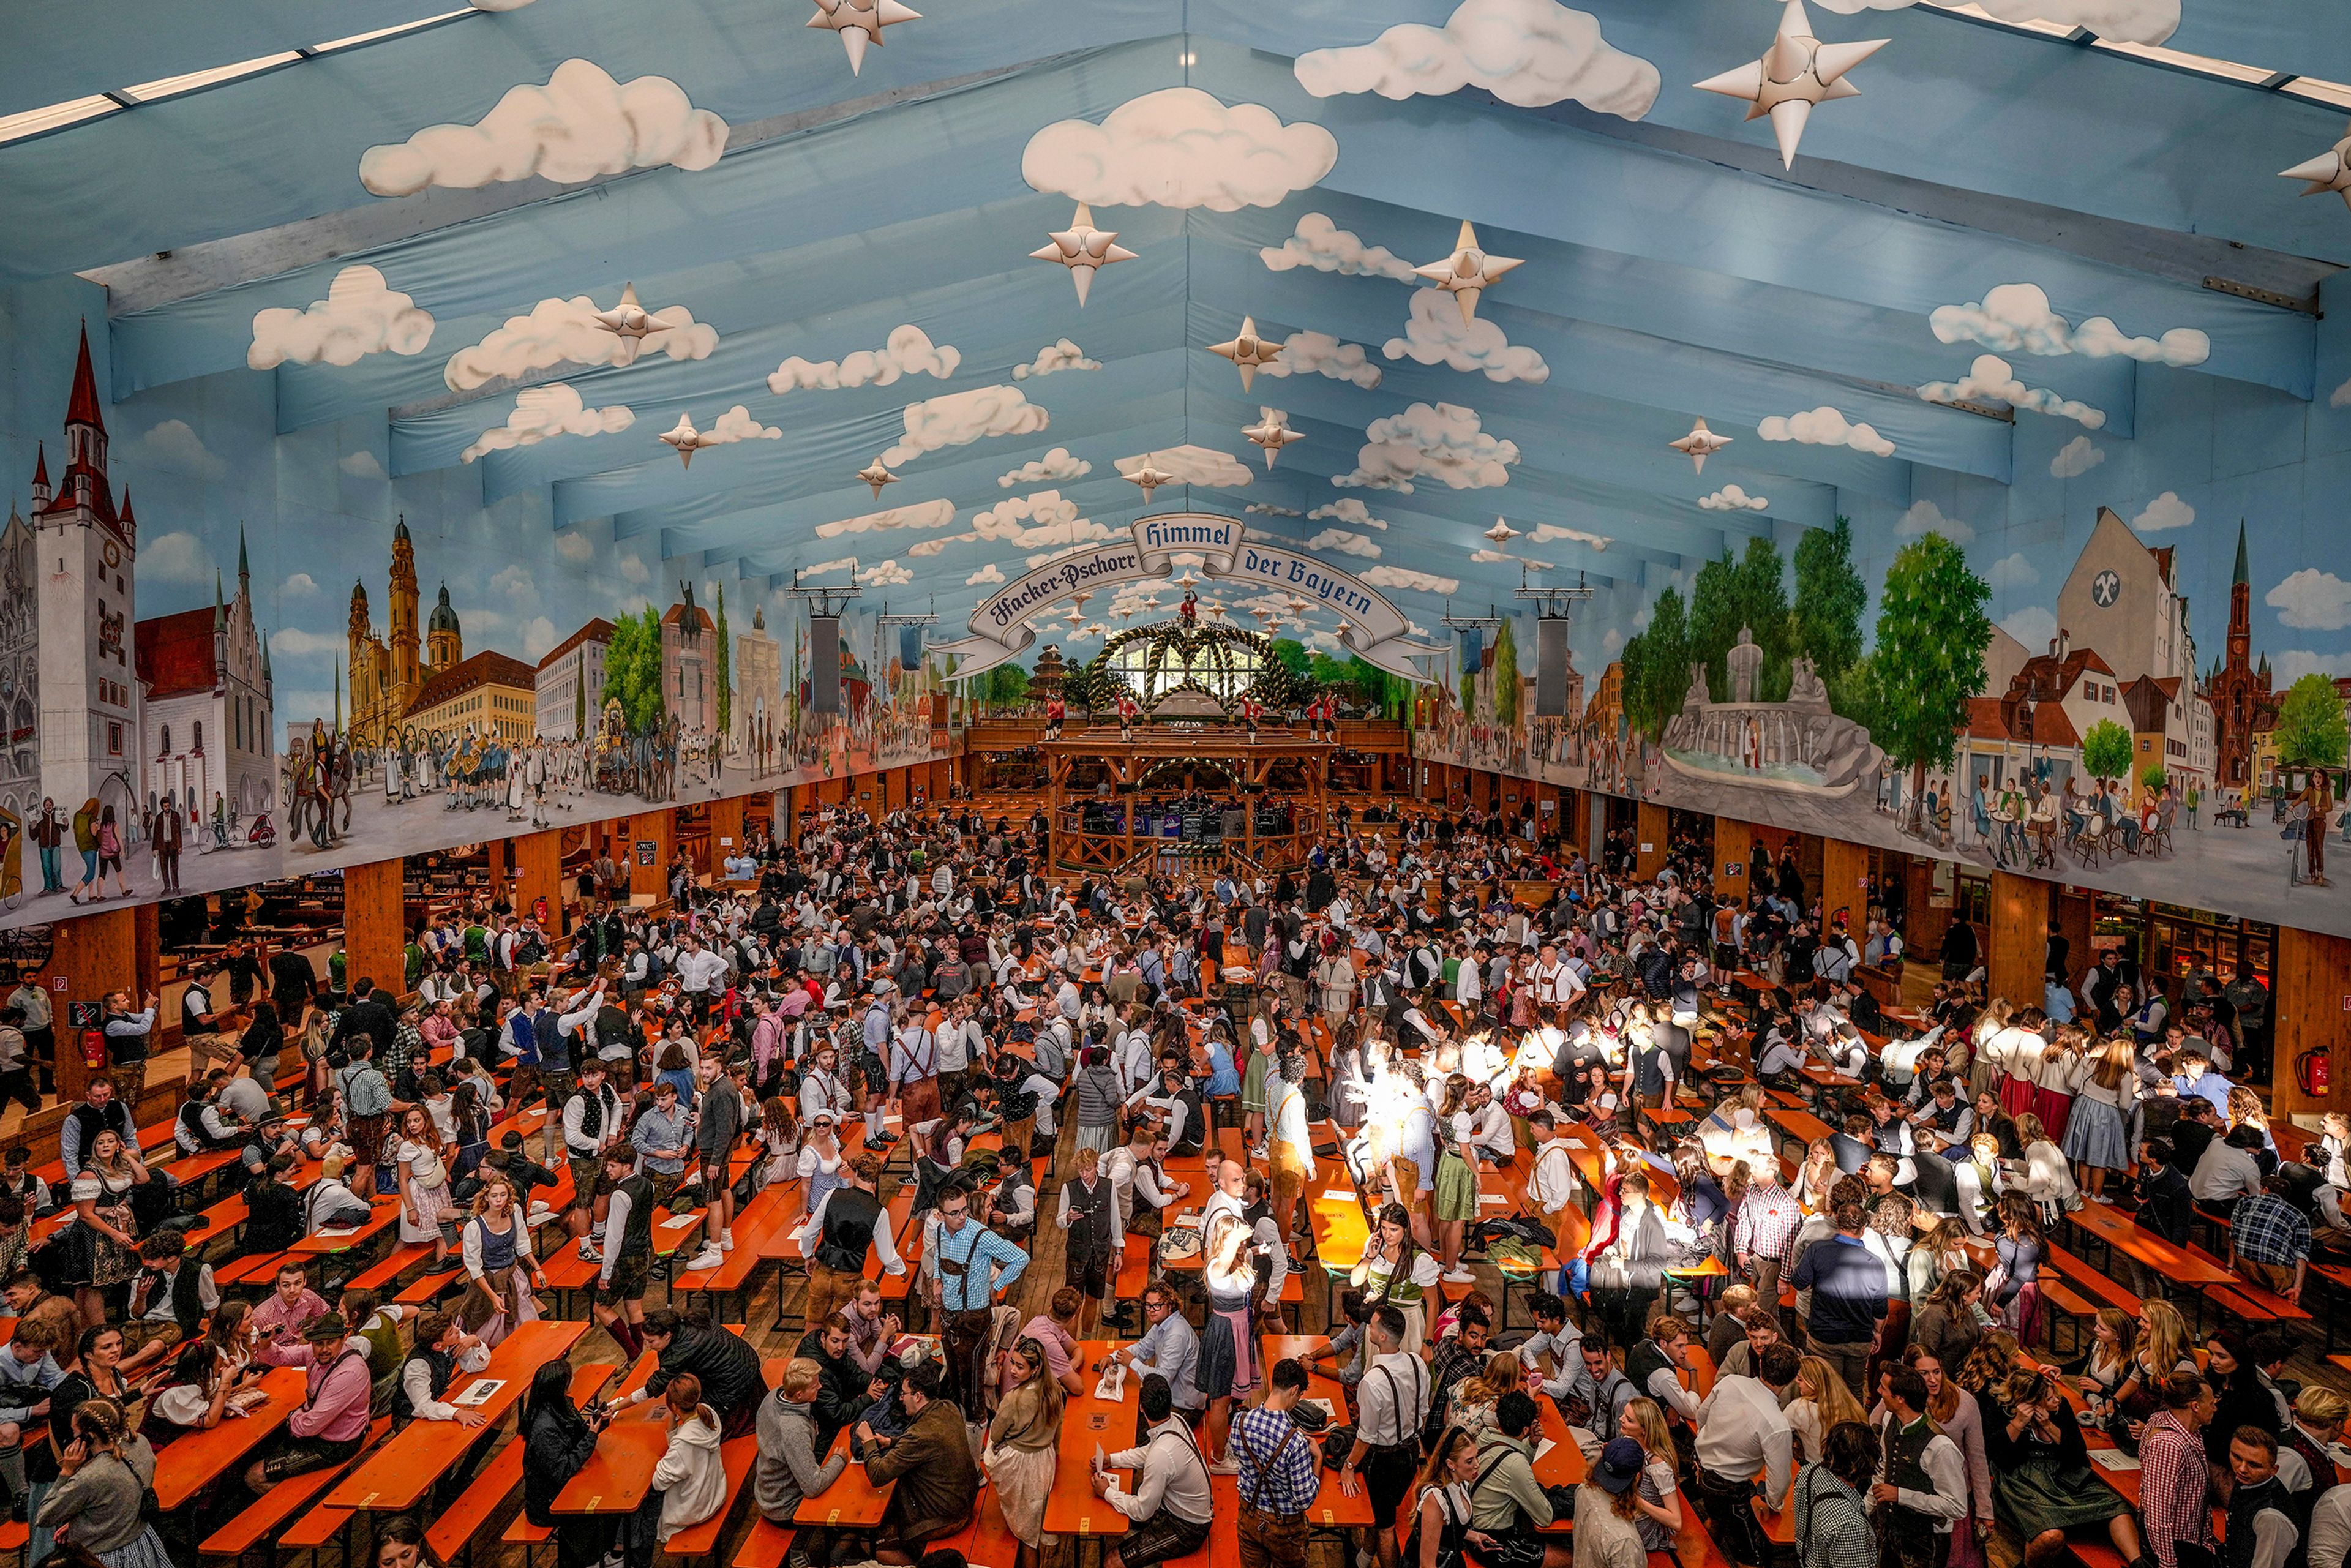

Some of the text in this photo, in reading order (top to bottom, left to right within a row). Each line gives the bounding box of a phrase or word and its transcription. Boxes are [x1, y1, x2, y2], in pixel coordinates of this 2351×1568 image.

[1146, 522, 1230, 548] Himmel
[990, 554, 1135, 626] Hacker-Pschorr
[1245, 549, 1371, 615] der Bayern
